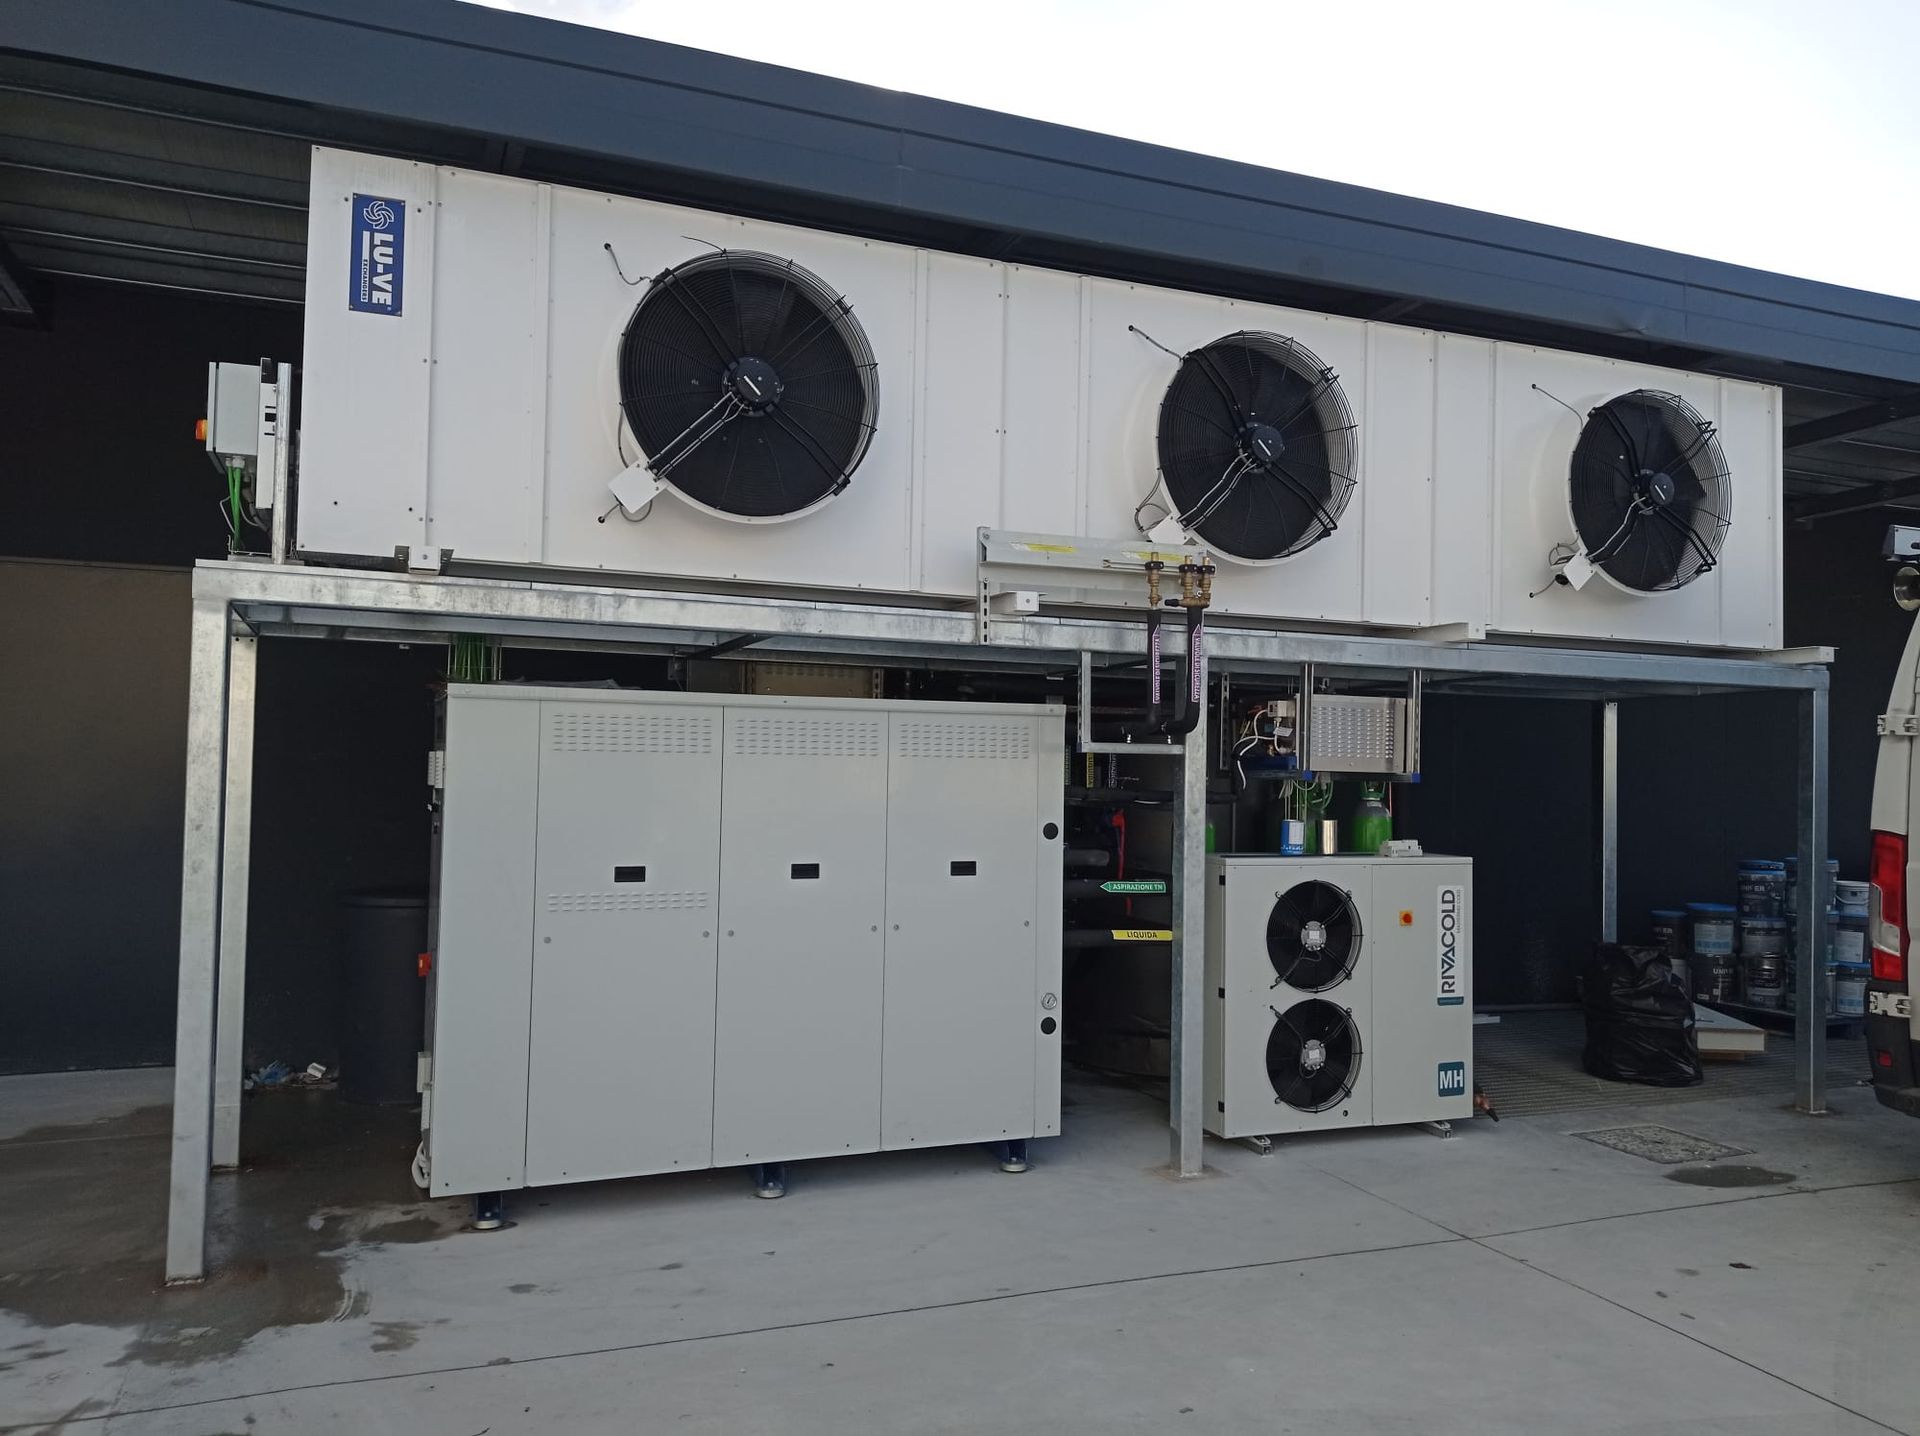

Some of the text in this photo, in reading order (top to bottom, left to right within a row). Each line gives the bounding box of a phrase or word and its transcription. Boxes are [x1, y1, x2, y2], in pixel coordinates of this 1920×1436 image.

[371, 232, 394, 305] LU-VE
[1112, 882, 1163, 890] ASPIRAZIONE TN
[1441, 889, 1455, 994] RIVACOLD
[1439, 1069, 1464, 1090] MH
